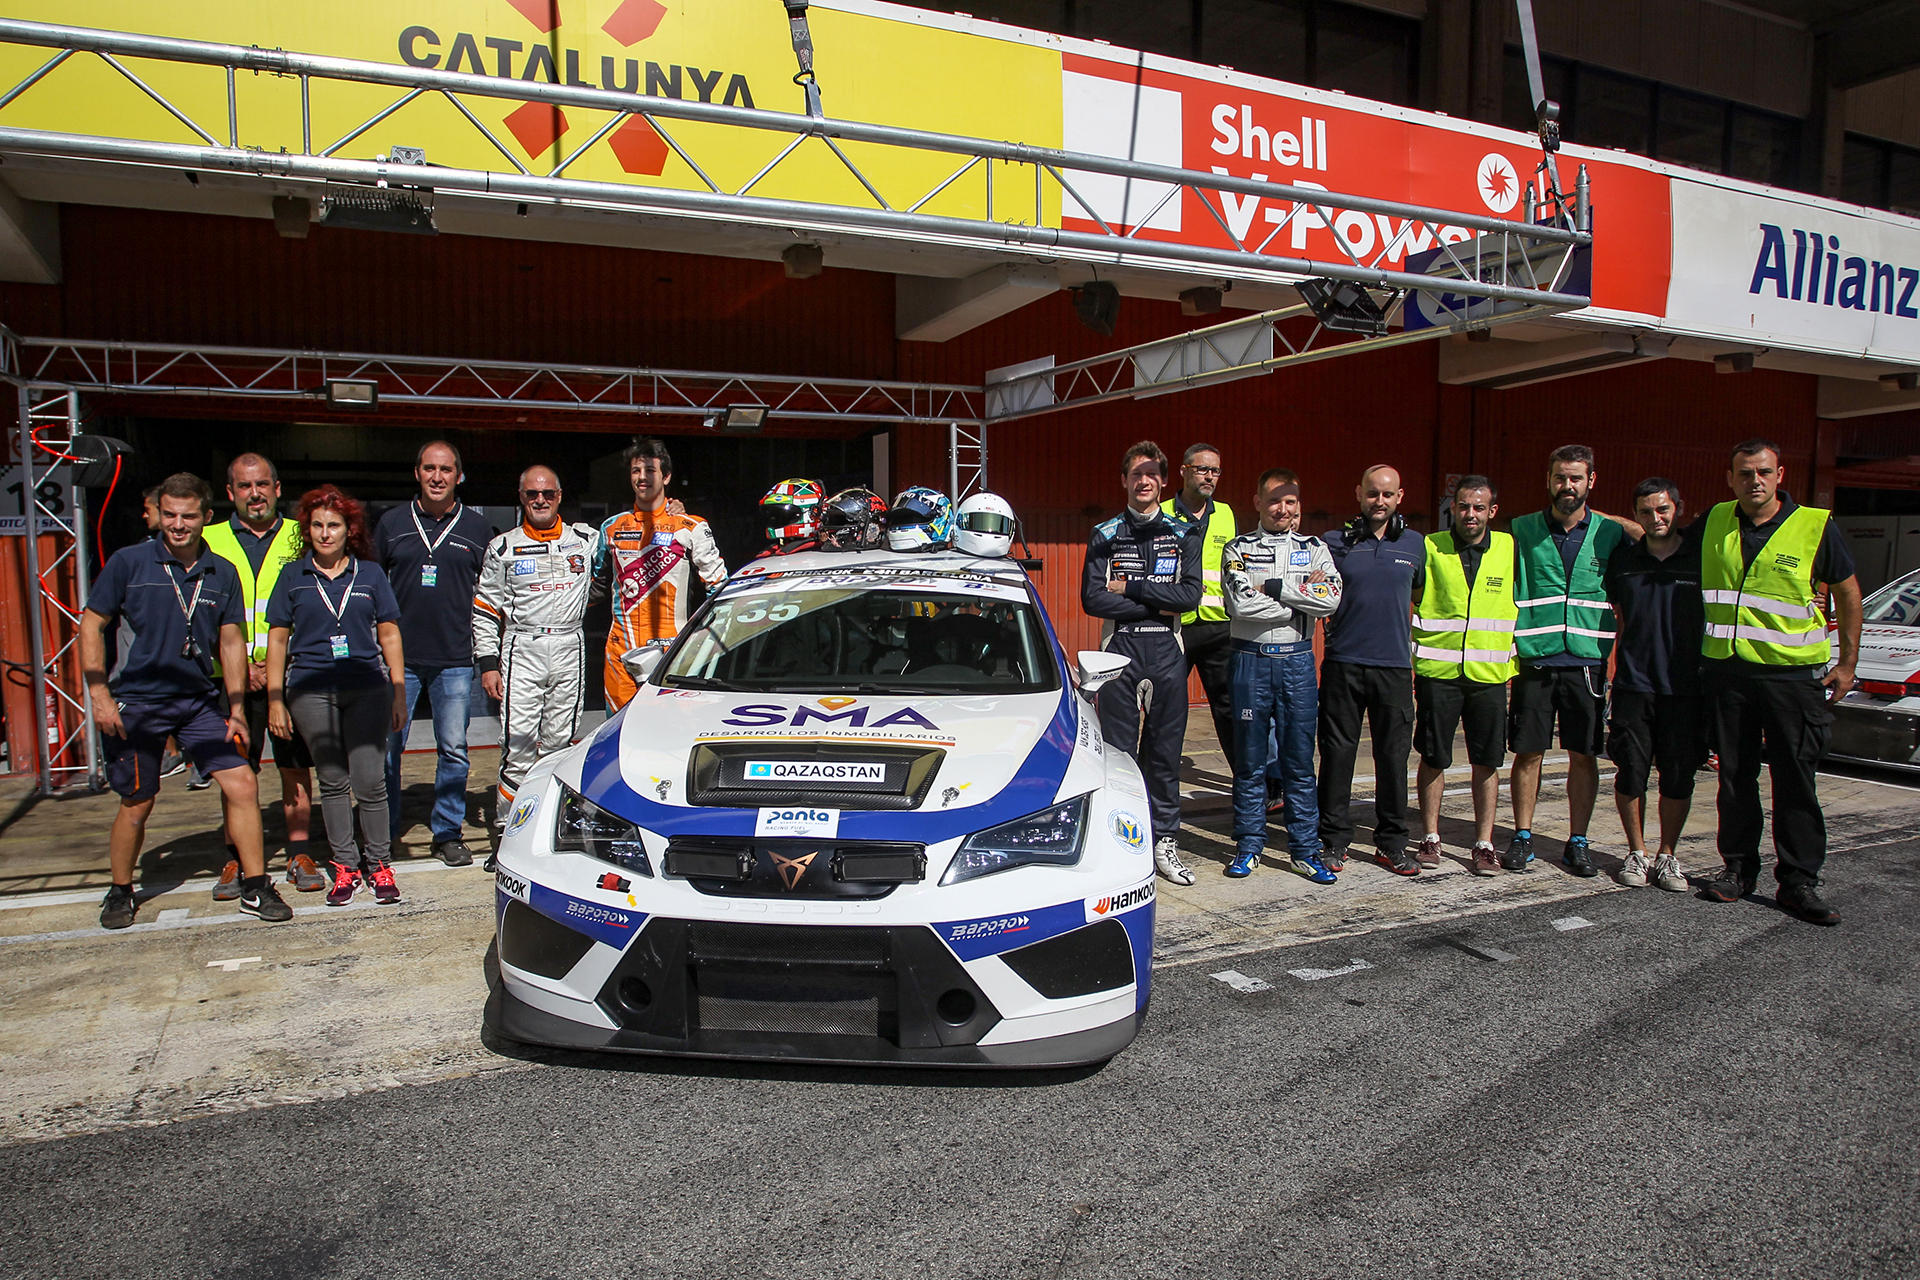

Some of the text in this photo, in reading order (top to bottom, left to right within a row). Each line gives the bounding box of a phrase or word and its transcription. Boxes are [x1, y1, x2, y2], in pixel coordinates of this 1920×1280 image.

[398, 25, 758, 110] CATALUNYA
[1210, 103, 1328, 172] Shell
[1749, 222, 1920, 319] Allianz
[655, 532, 673, 541] 24H
[632, 545, 672, 580] SANCOR
[1157, 559, 1176, 569] 24H
[1291, 552, 1310, 561] 24H
[516, 560, 534, 569] 24H
[639, 551, 677, 588] SEGUROS
[899, 570, 993, 583] BARCELONA
[529, 581, 574, 592] SEAT
[736, 599, 804, 623] 35
[720, 704, 941, 731] SMA
[824, 730, 957, 741] INMOBILIARIOS
[773, 763, 881, 779] QAZAQSTAN
[766, 809, 830, 824] panta
